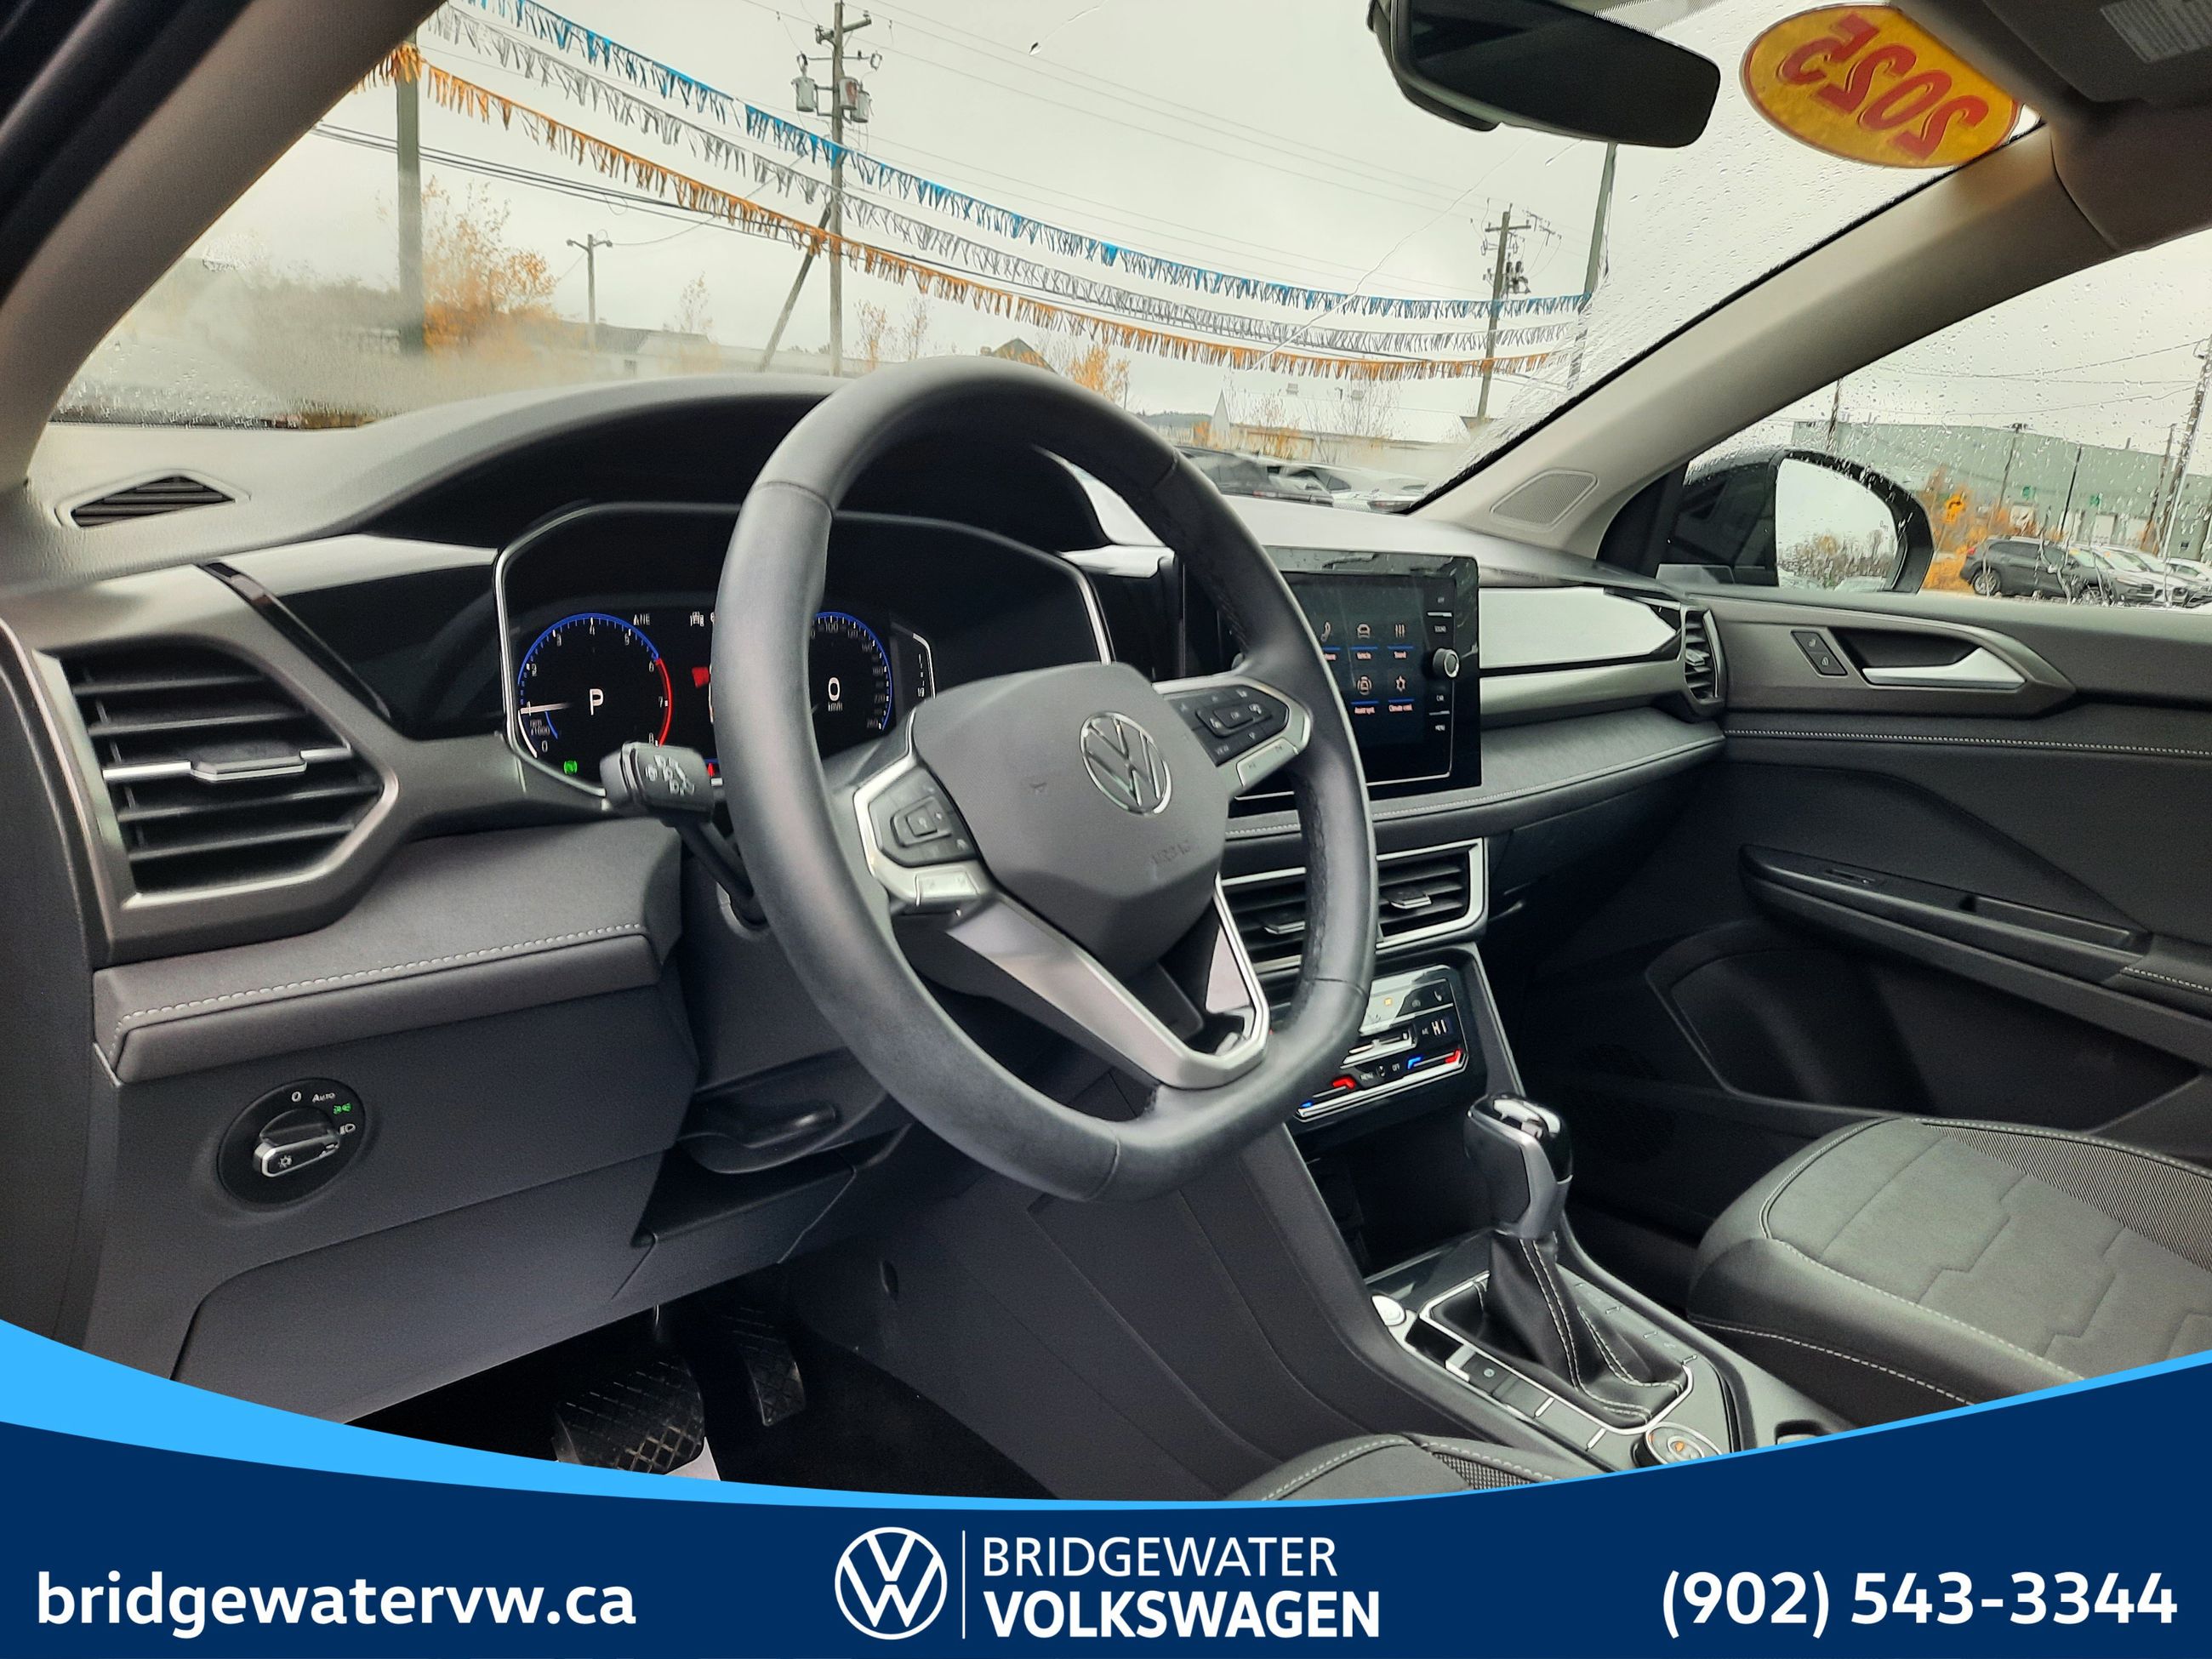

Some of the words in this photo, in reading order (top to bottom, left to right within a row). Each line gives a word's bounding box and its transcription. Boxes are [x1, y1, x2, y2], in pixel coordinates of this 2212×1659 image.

[825, 623, 839, 632] 100
[828, 676, 841, 701] 0
[589, 687, 604, 715] P
[541, 740, 549, 753] 0
[1431, 1018, 1447, 1036] HI
